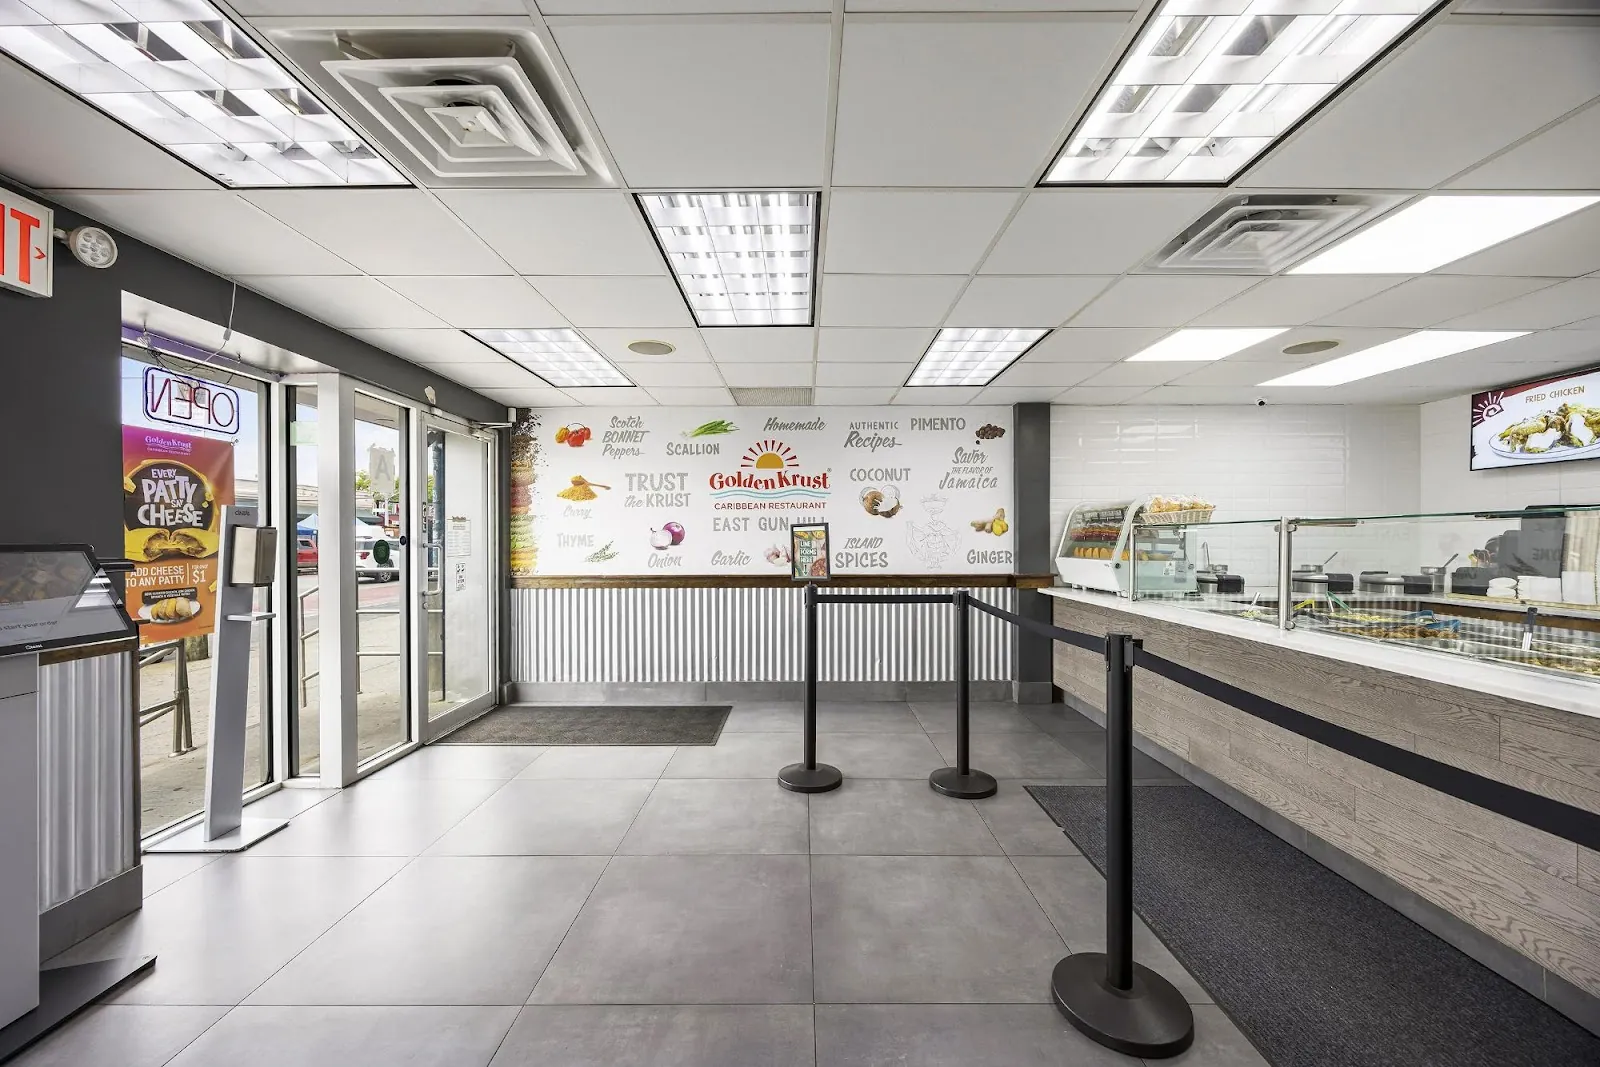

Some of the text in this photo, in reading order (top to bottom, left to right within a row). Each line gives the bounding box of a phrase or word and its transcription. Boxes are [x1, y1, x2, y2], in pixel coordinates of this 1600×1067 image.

[1525, 385, 1585, 403] FRIED CHICKEN
[610, 416, 644, 428] Scotch
[764, 417, 827, 432] Homemade
[849, 421, 899, 430] AUTHENTIC
[911, 418, 966, 431] PIMENTO
[602, 431, 650, 443] BONNET
[844, 431, 902, 452] Recipes
[602, 444, 645, 459] Peppers
[666, 442, 720, 456] SCALLION
[952, 446, 988, 464] Savor
[151, 469, 177, 478] EVERY
[849, 468, 911, 481] COCONUT
[939, 471, 998, 489] Jamaica
[625, 472, 689, 491] TRUST
[142, 476, 197, 503] PATTY
[171, 499, 183, 508] SAY
[624, 493, 691, 508] the KRUST
[714, 502, 827, 510] CARIBBEAN RESTAURANT
[138, 503, 203, 526] CHEESE
[563, 505, 593, 519] Curry
[713, 517, 749, 531] EAST
[758, 517, 788, 531] GUN
[557, 533, 594, 548] THYME
[843, 537, 883, 549] ISLAND
[648, 553, 682, 568] Onion
[711, 550, 751, 566] Garlic
[835, 552, 889, 568] SPICES
[967, 550, 1013, 564] GINGER
[151, 565, 184, 576] CHEESE
[192, 569, 207, 584] $1
[125, 575, 185, 587] TO ANY PATTY
